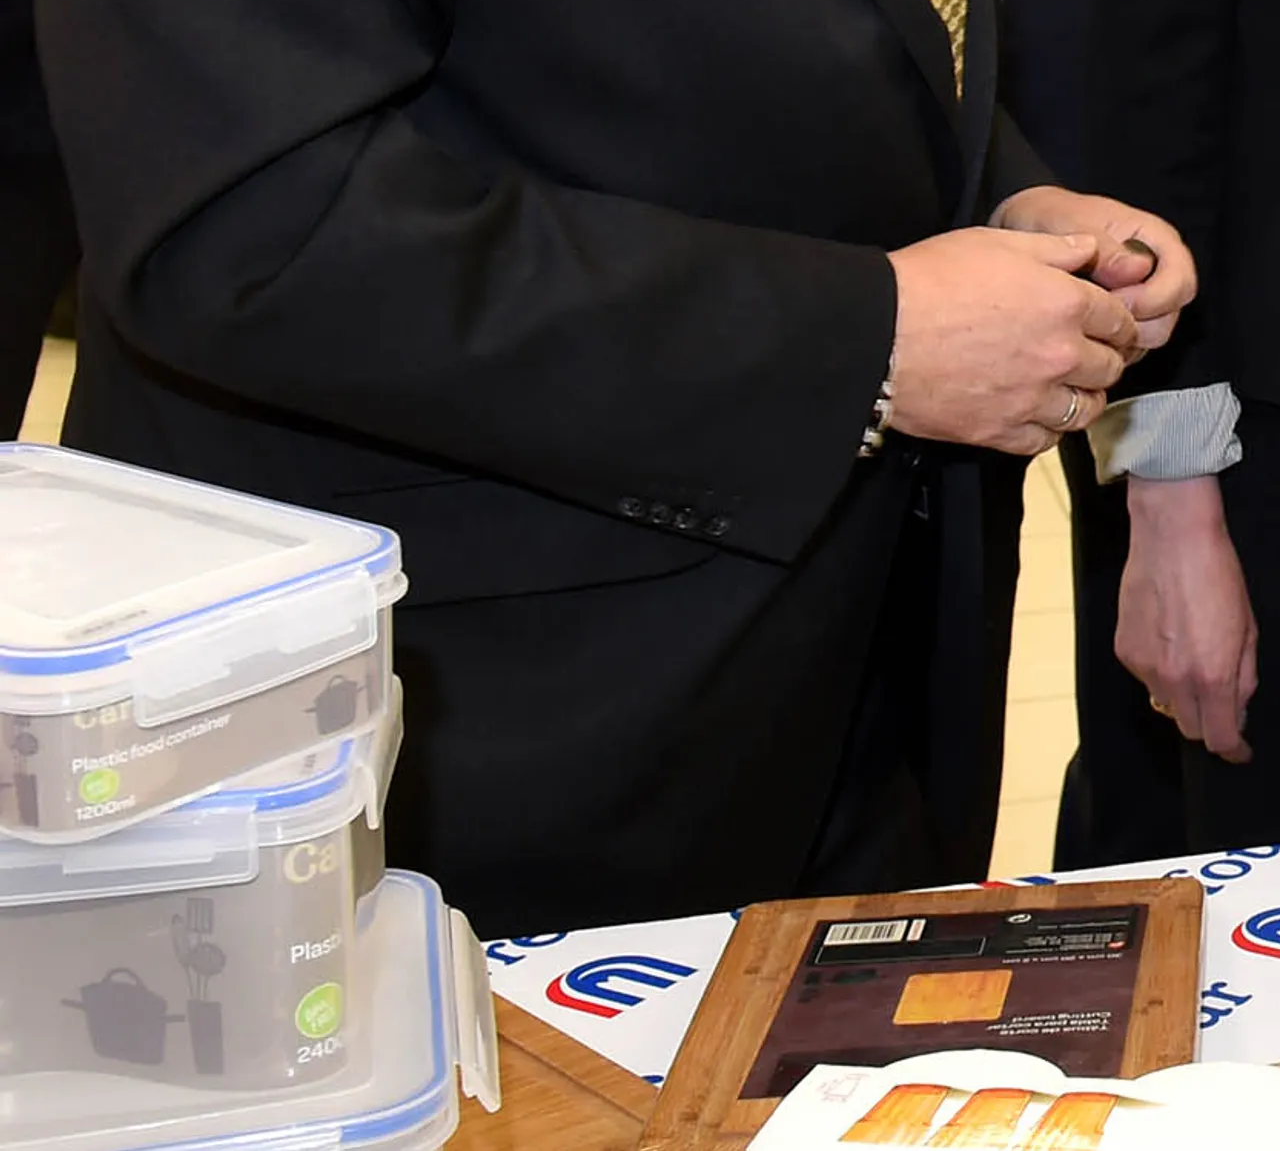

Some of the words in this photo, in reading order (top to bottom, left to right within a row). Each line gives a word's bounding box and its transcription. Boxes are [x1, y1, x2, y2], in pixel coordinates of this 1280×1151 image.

[71, 750, 128, 775] Plastic
[130, 735, 165, 760] food
[166, 713, 232, 747] container
[75, 795, 136, 821] 1200ml
